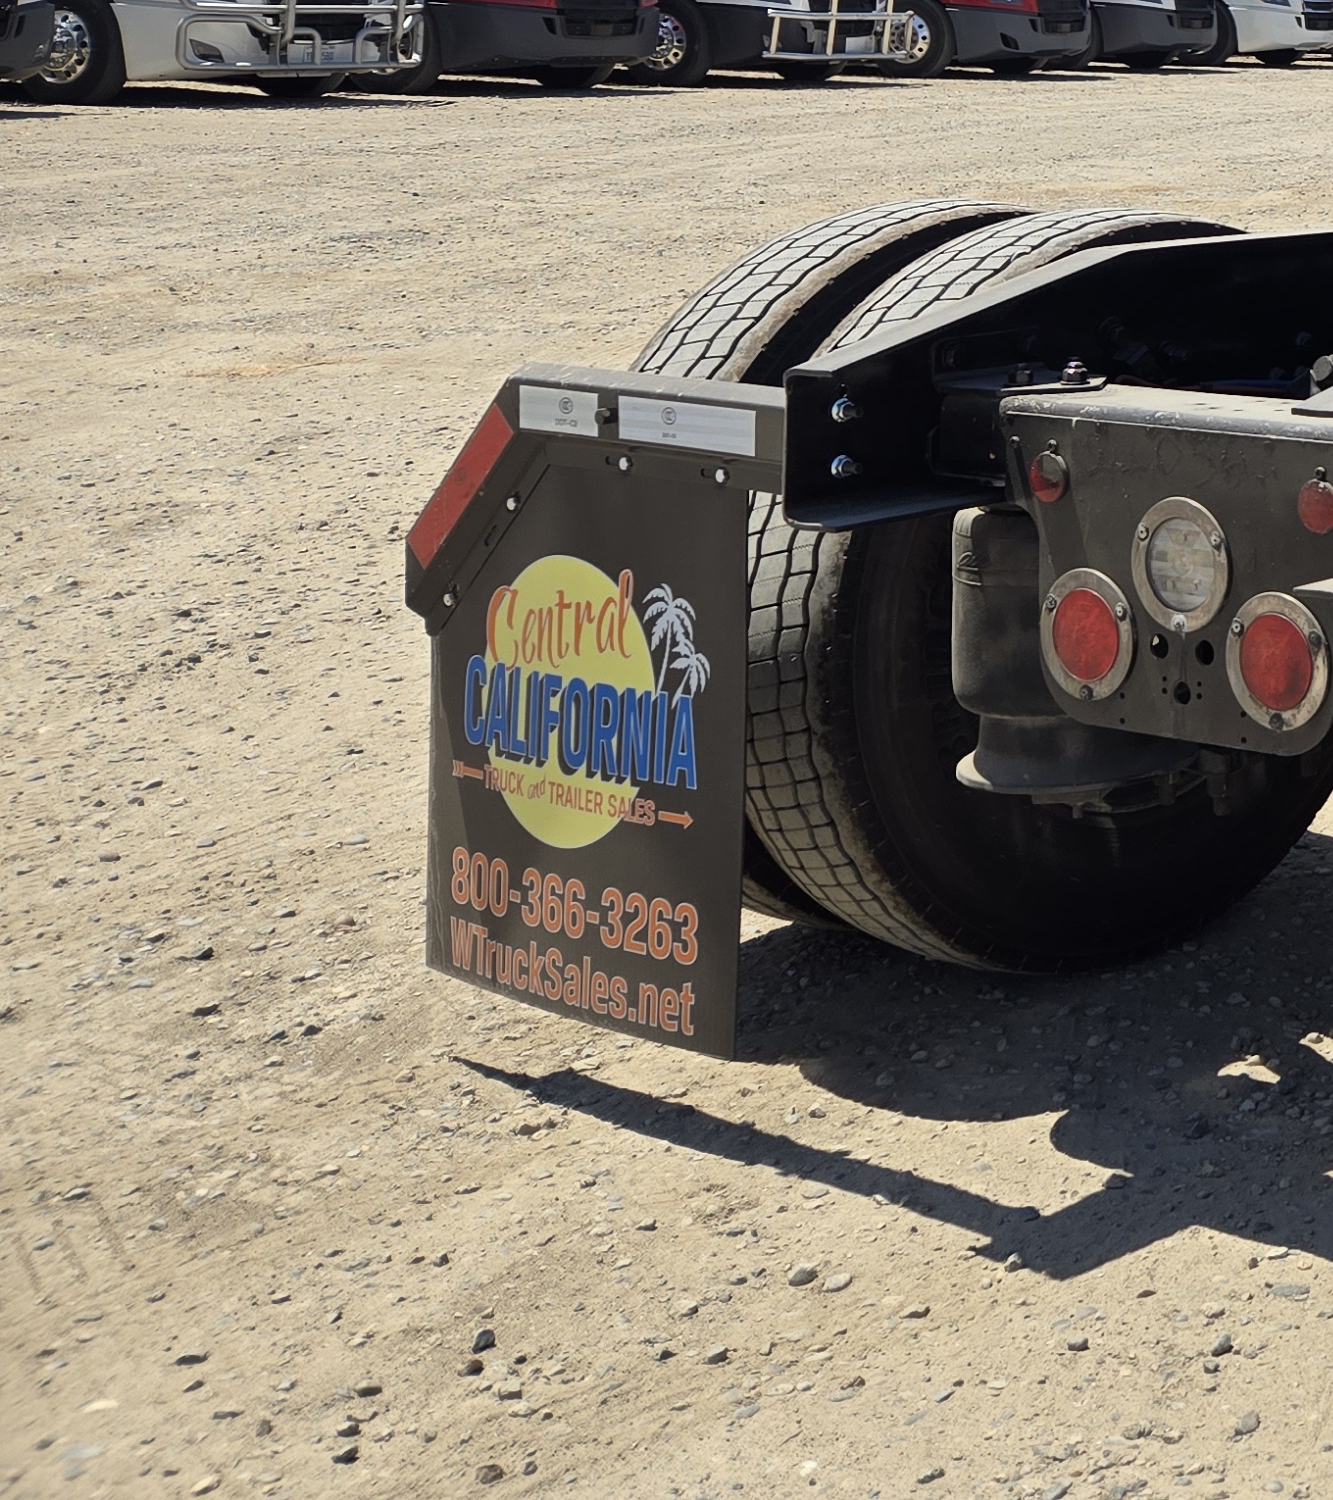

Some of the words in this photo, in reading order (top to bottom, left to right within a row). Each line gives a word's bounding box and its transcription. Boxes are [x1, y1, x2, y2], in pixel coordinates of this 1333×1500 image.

[486, 568, 633, 672] Central
[463, 654, 698, 791] CALIFORNIA
[484, 763, 524, 796] TRUCK
[527, 772, 546, 800] and
[548, 780, 603, 814] TRAILER
[607, 793, 656, 826] SALES
[451, 845, 699, 966] 800-366-3263
[450, 915, 696, 1037] WTruckSales.net
